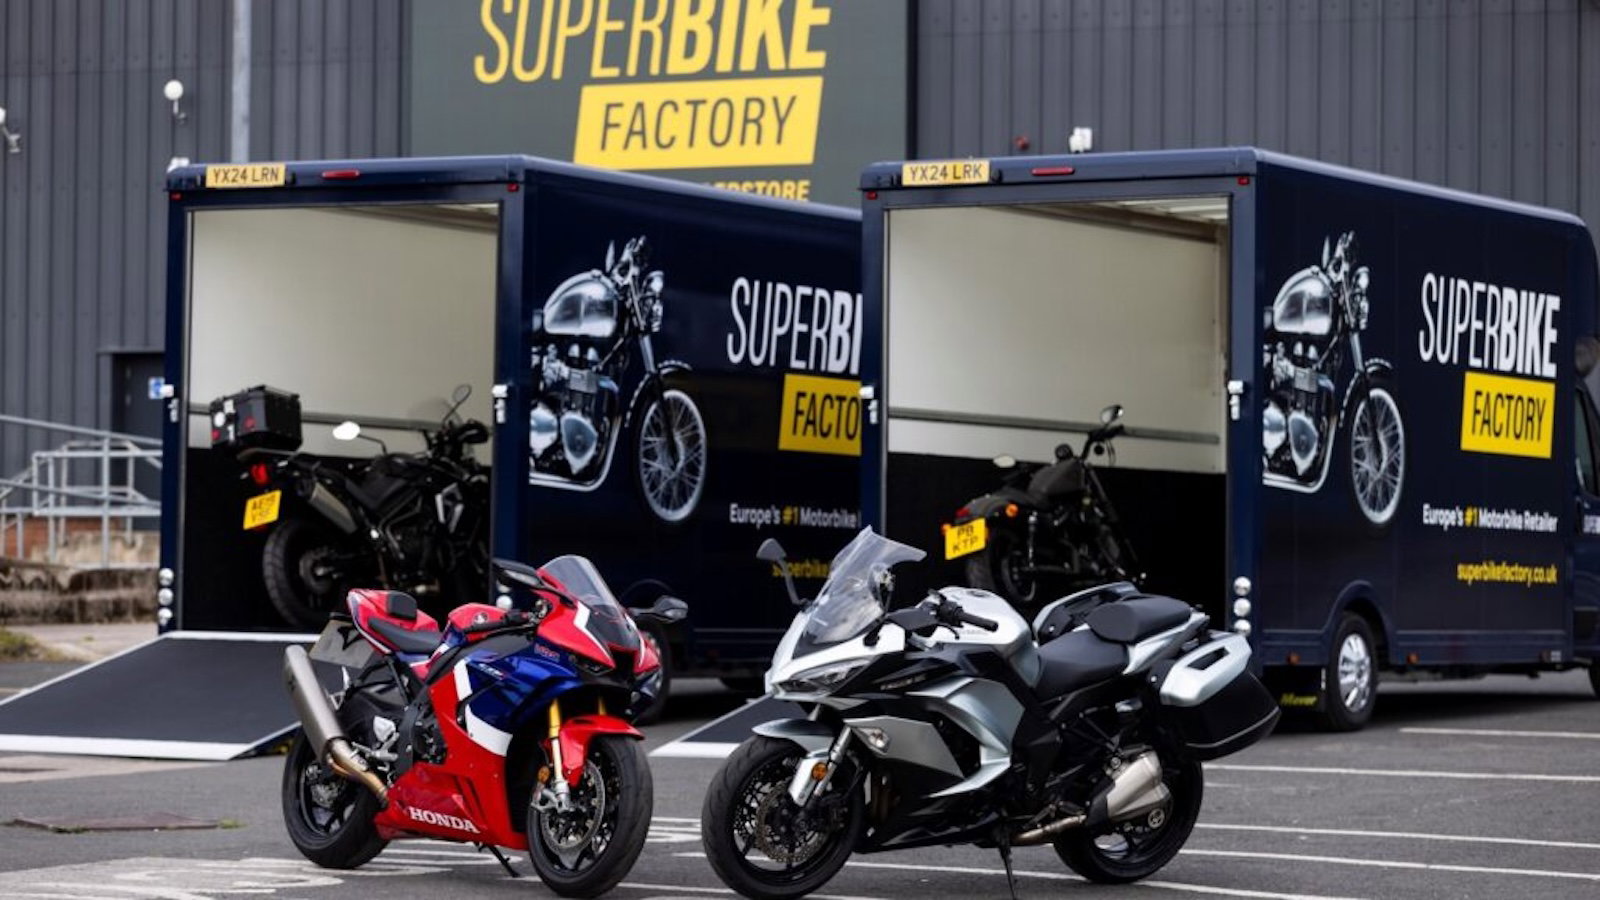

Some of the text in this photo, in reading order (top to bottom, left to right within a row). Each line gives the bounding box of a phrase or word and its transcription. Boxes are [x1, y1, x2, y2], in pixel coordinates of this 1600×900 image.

[473, 0, 831, 84] SUPERBIKE
[599, 96, 797, 152] FACTORY
[213, 167, 279, 183] YX24 LRN
[910, 164, 982, 181] YX24 LRK
[1419, 272, 1561, 378] SUPERBIKE
[1471, 390, 1547, 442] FACTORY
[729, 503, 780, 530] Europe's
[782, 506, 799, 525] #1
[800, 507, 857, 528] Motorbike
[1422, 503, 1463, 531] Europe's
[1465, 506, 1478, 527] #1
[1479, 507, 1522, 531] Motorbike
[1524, 510, 1558, 532] Retailer
[1457, 560, 1557, 587] superbikefactory.co.uk
[408, 806, 481, 834] HONDA
